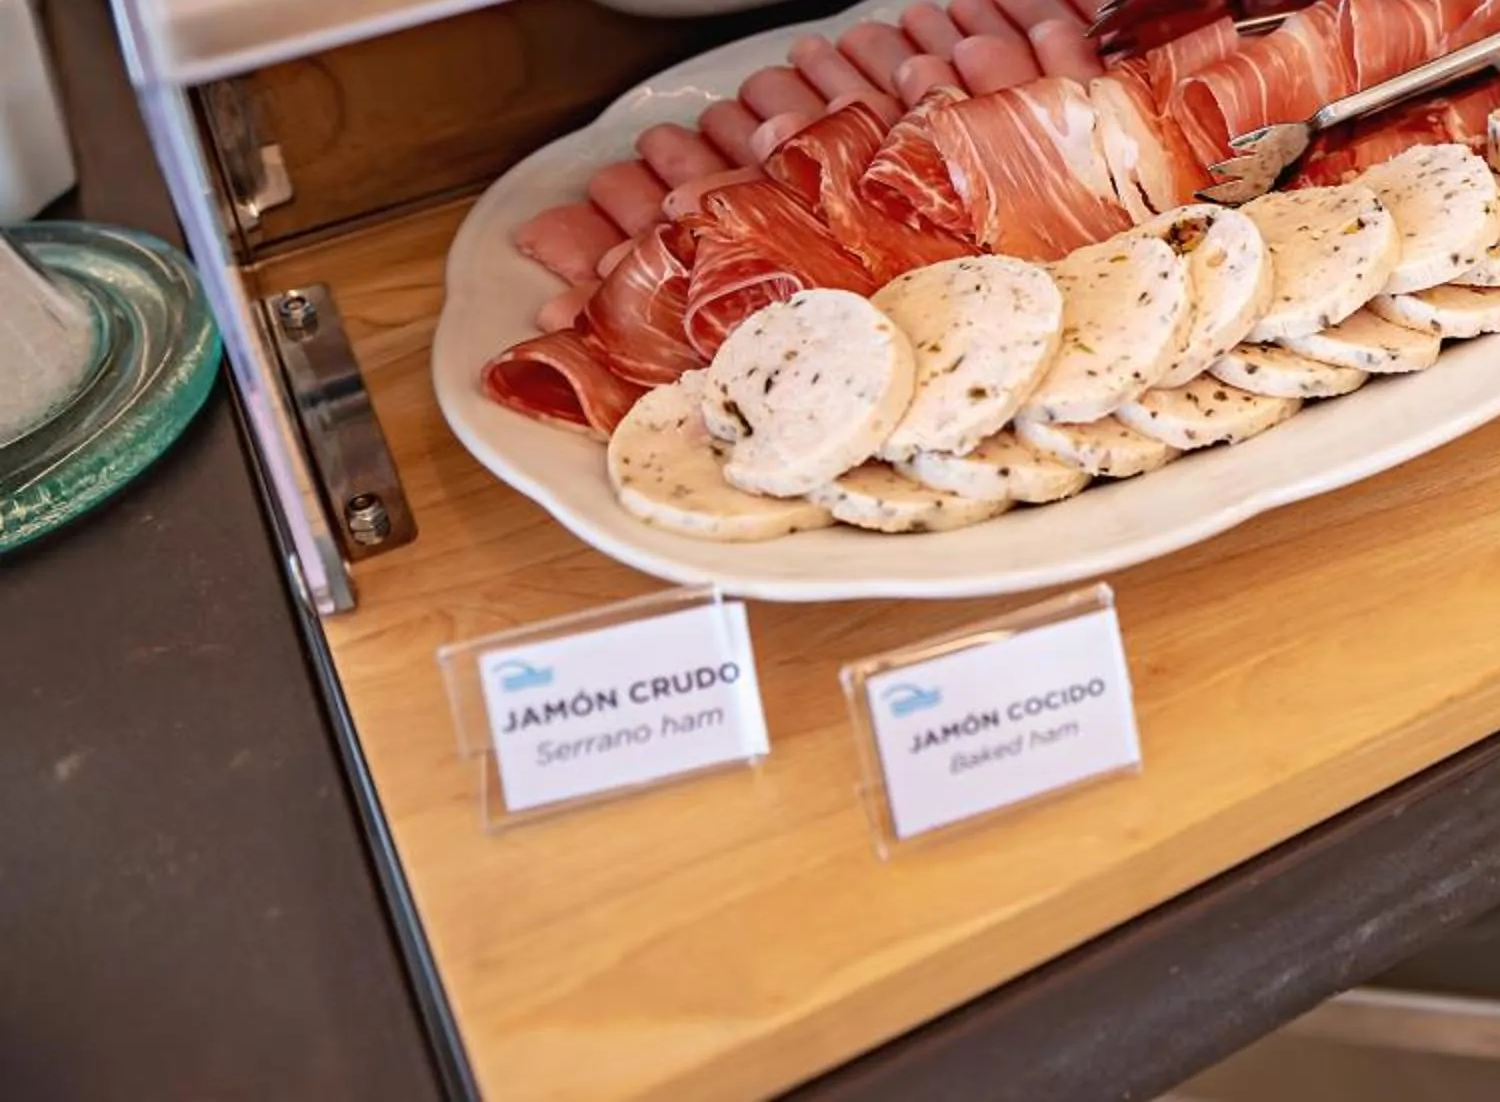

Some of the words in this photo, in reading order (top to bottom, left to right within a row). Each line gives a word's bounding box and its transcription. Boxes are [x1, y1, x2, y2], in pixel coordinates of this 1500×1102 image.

[502, 687, 619, 734] JAMÓN
[629, 661, 740, 705] CRUDO
[909, 707, 1000, 755] JAMÓN
[1006, 676, 1106, 722] COCIDO
[536, 723, 653, 767] Serrano
[660, 706, 725, 738] ham
[950, 732, 1024, 775] Baked
[1029, 721, 1080, 749] ham
